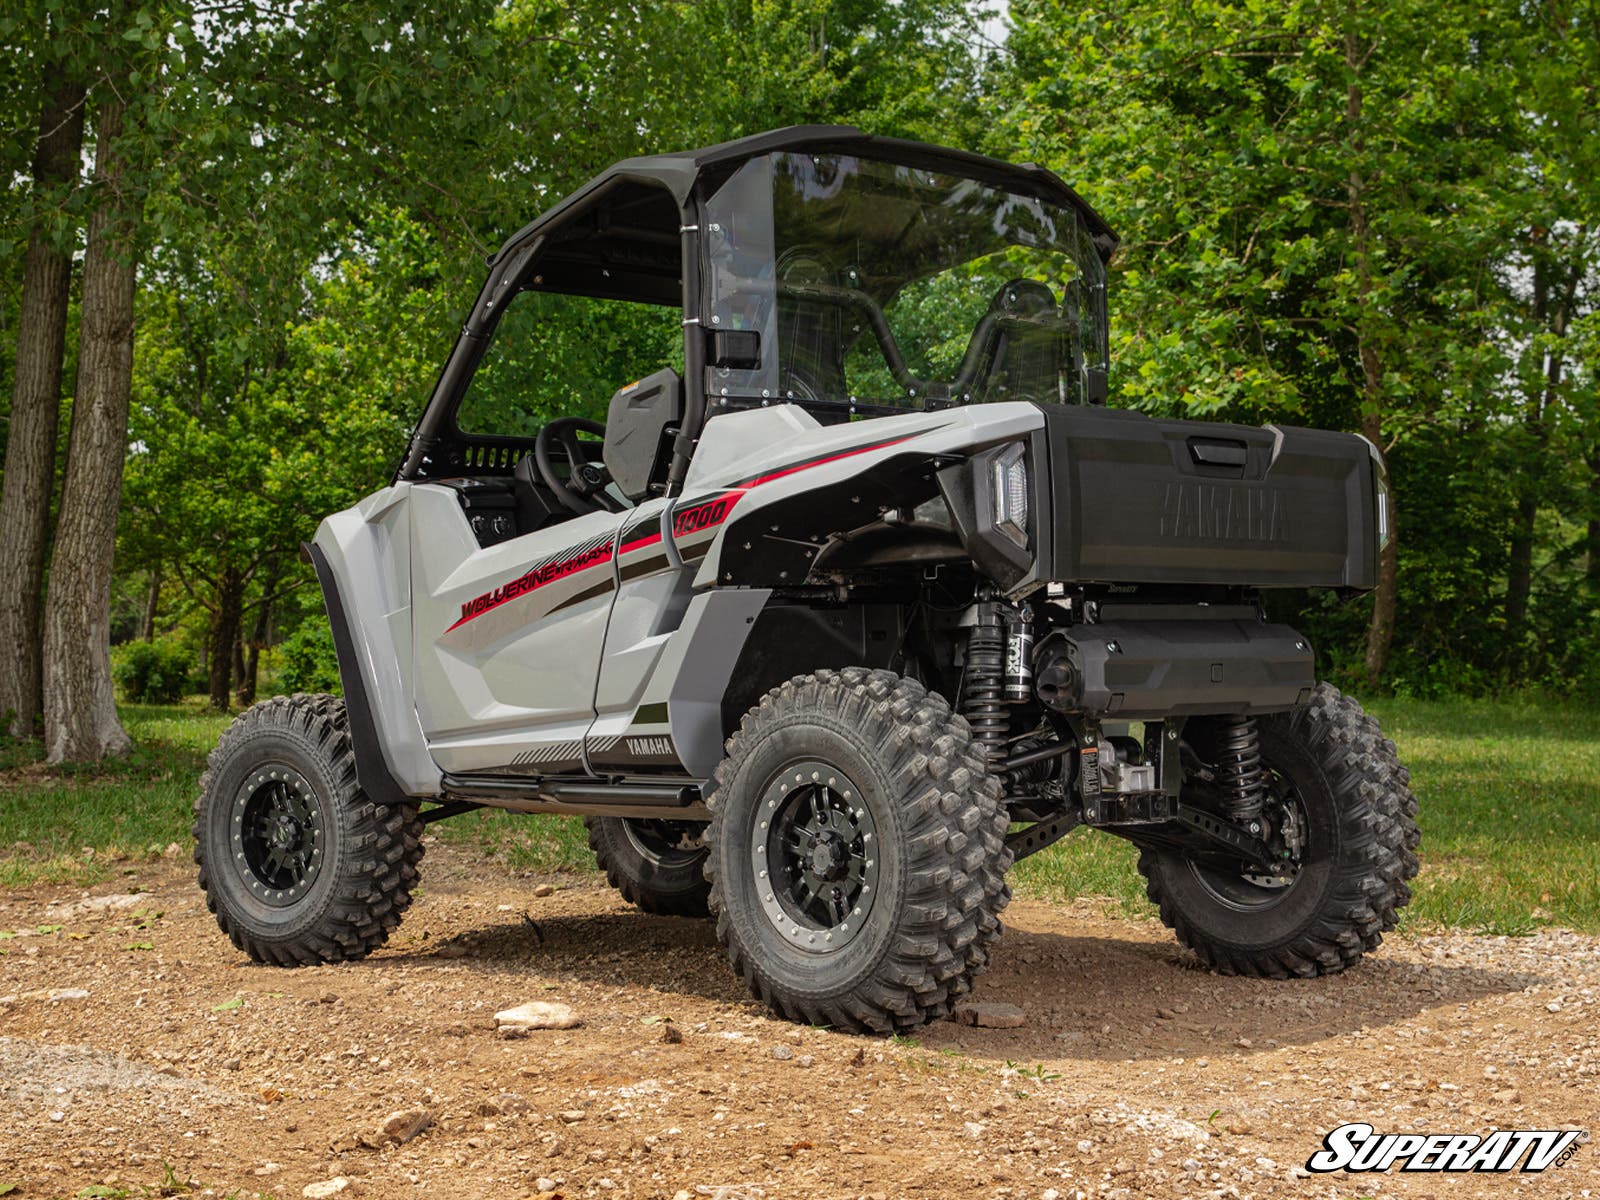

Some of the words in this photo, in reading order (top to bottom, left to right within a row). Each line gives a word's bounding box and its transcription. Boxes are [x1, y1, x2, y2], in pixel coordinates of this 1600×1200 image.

[676, 502, 727, 535] 1000
[1159, 482, 1289, 541] YAMAHA
[1007, 637, 1021, 674] FOX
[626, 738, 673, 756] YAMAHA
